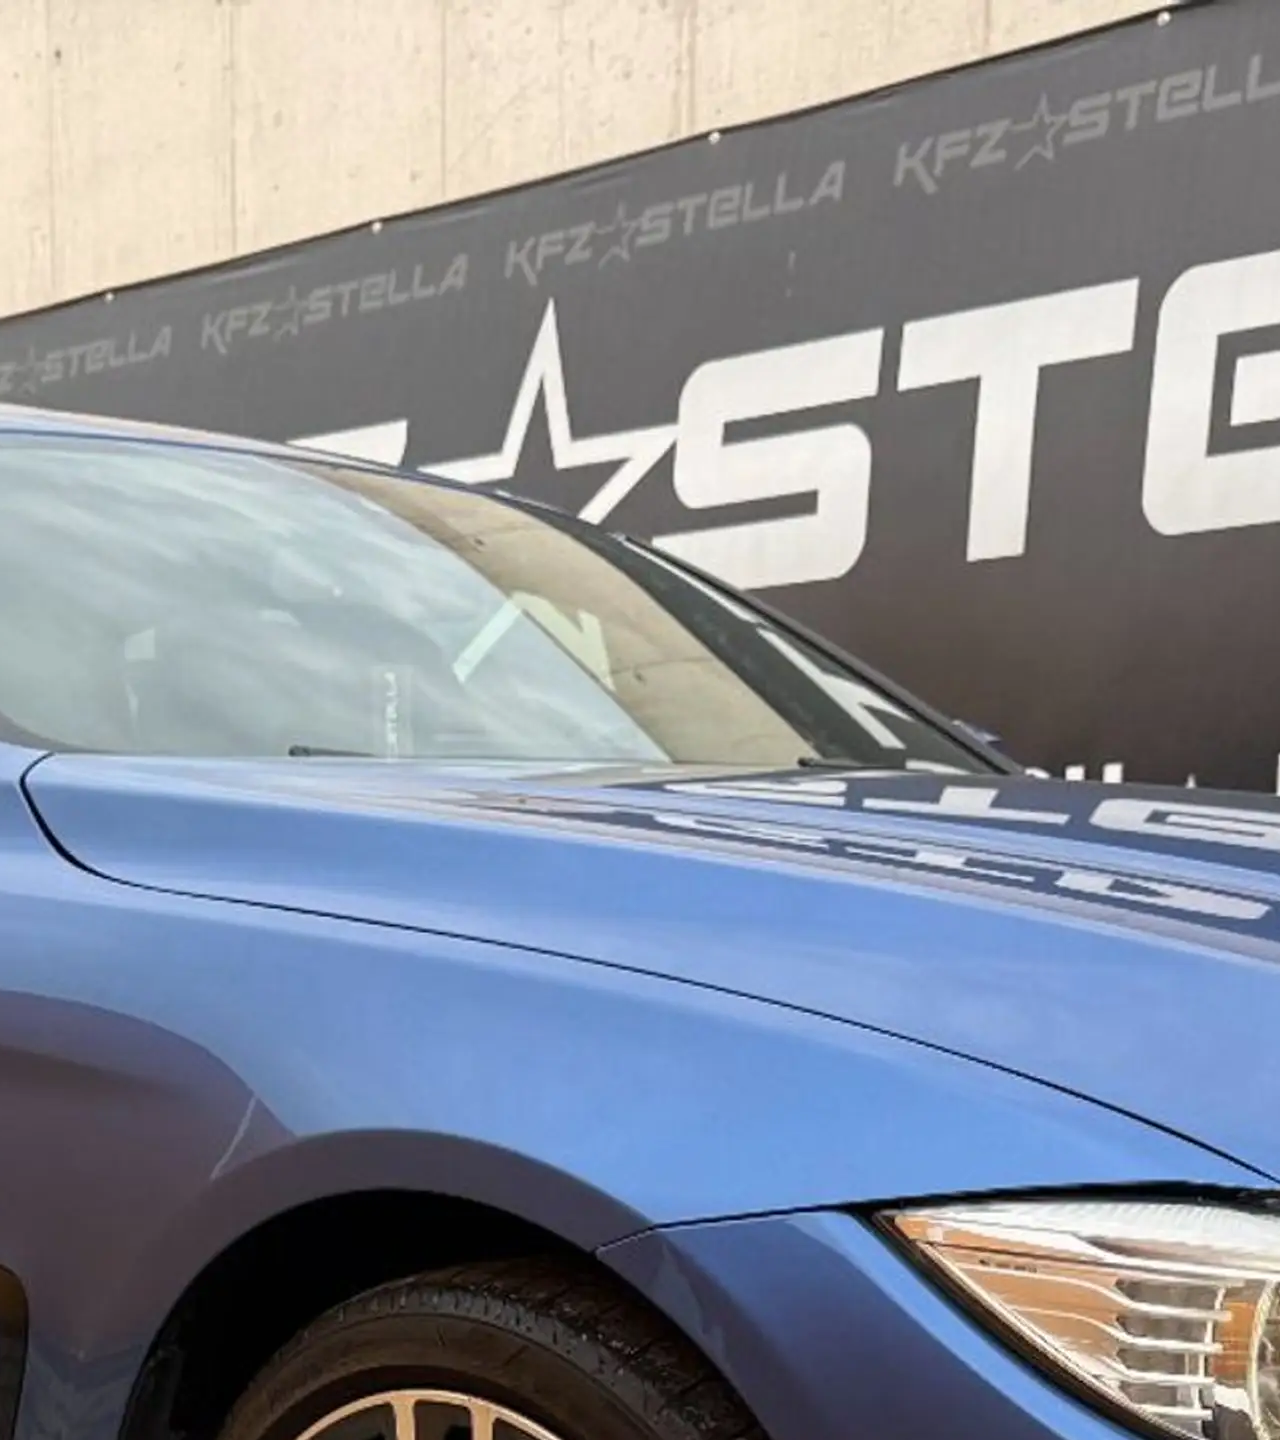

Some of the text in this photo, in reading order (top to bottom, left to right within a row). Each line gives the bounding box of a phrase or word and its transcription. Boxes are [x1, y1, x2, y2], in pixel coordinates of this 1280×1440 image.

[893, 117, 1011, 194] KFZ
[503, 221, 593, 288] KFZ
[201, 302, 272, 358] KFZ
